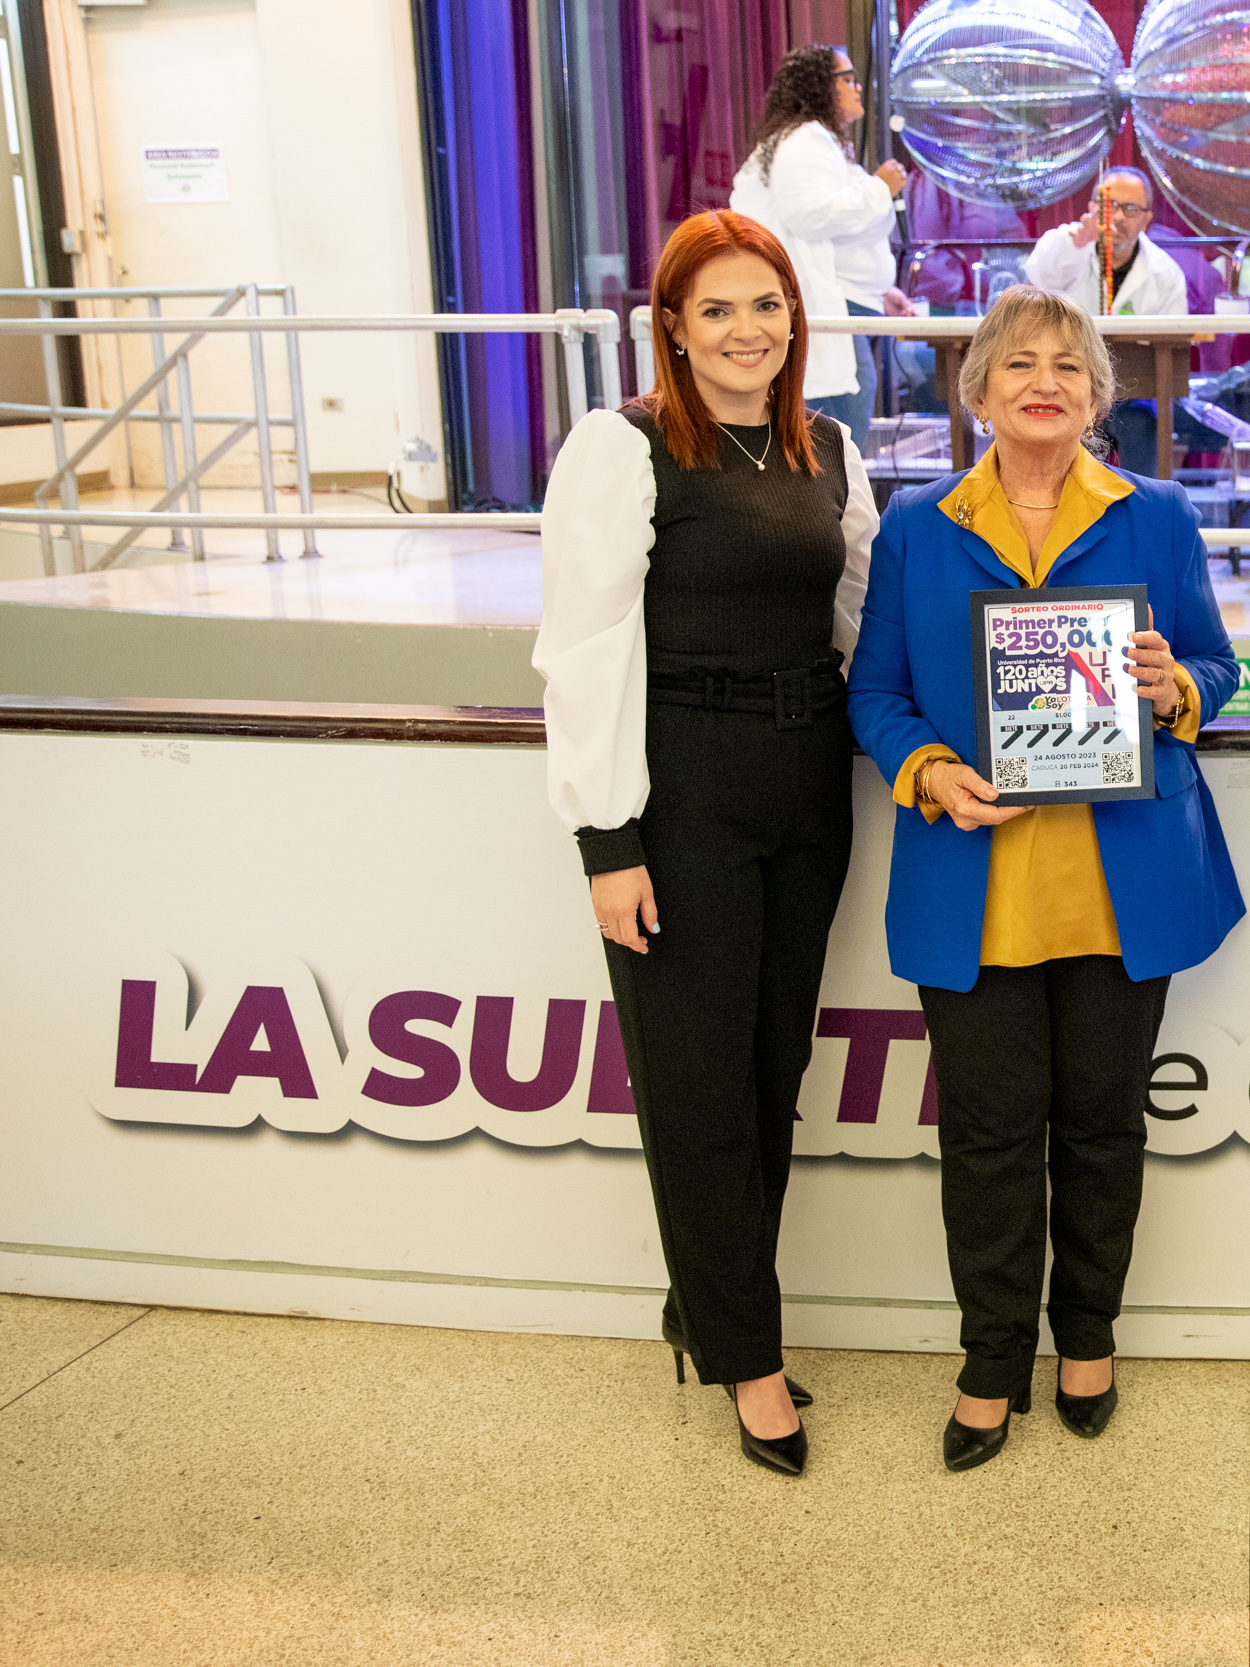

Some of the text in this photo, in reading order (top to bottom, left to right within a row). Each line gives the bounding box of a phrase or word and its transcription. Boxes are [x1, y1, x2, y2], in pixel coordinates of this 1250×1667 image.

[1010, 603, 1104, 614] SORTEO ORDINARIO
[997, 664, 1065, 680] 120 años
[1046, 702, 1064, 710] Soy
[114, 979, 319, 1100] LA
[1144, 1052, 1209, 1121] e
